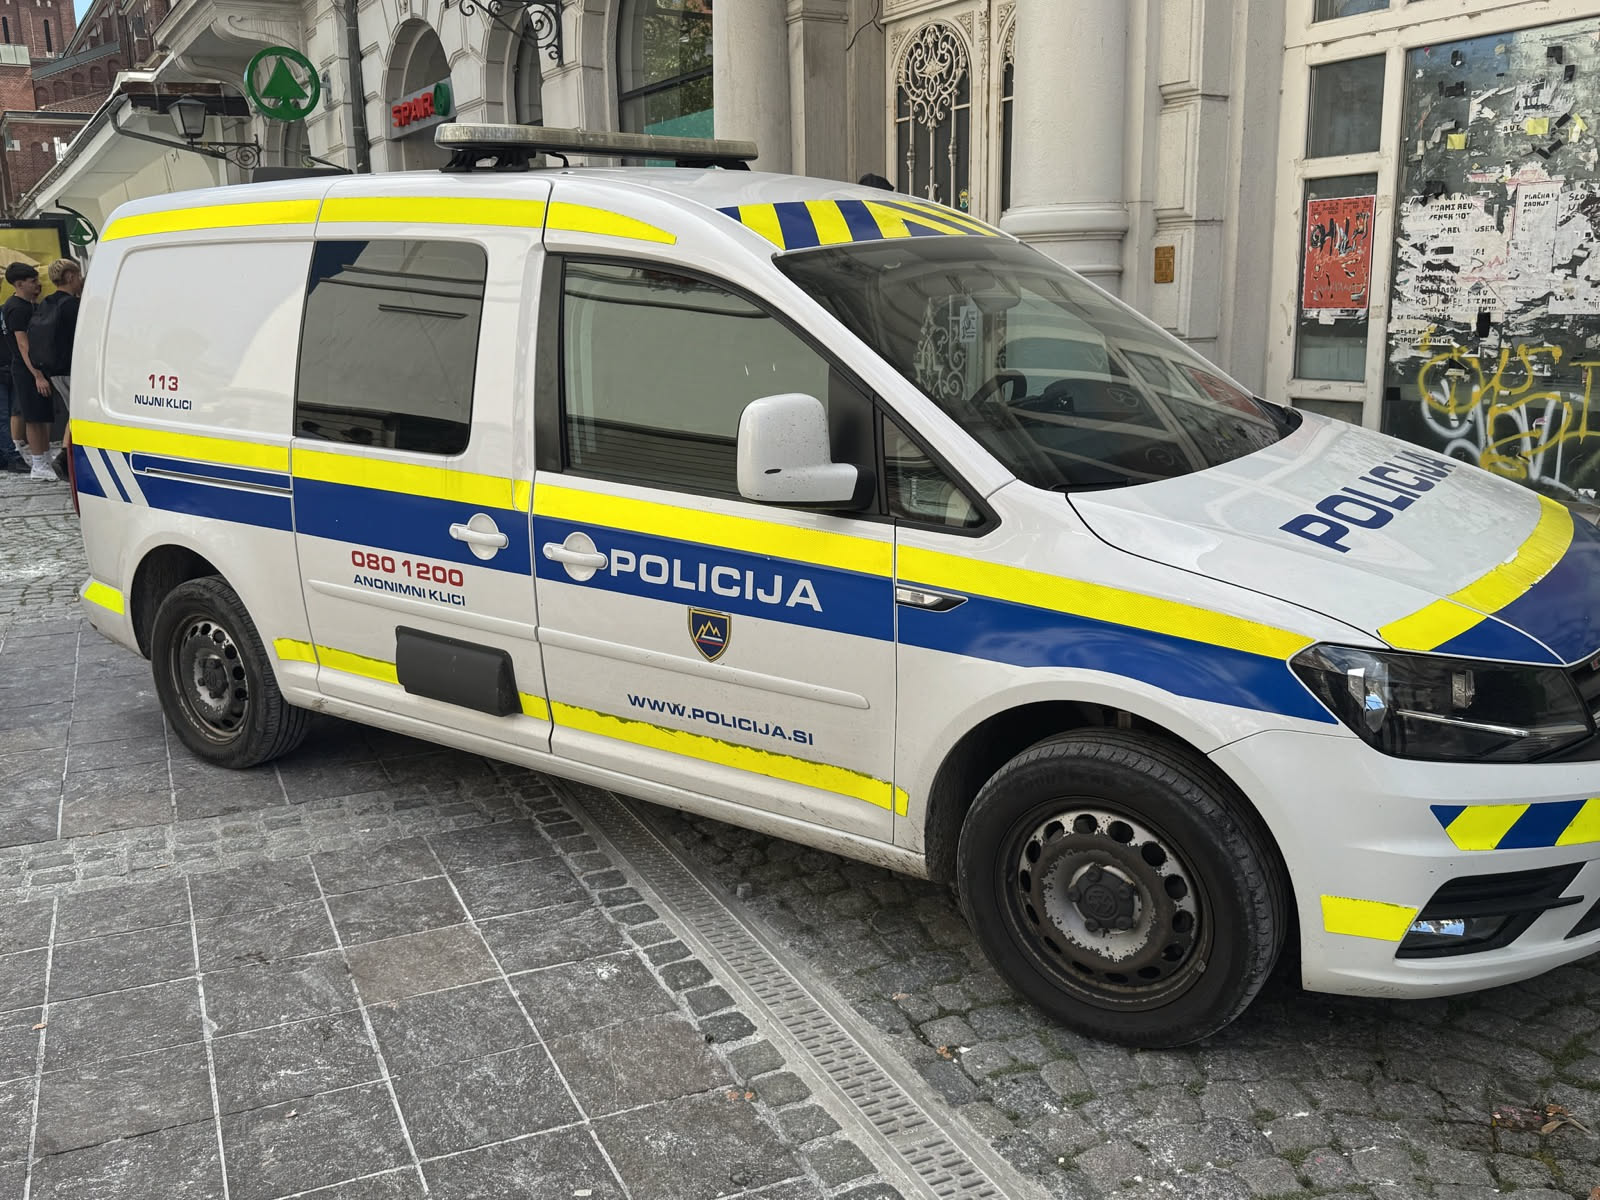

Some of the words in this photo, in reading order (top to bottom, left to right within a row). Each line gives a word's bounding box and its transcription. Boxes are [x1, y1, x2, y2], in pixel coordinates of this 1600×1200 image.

[391, 92, 435, 128] SPAR
[148, 374, 179, 391] 113
[134, 394, 164, 407] NUJNI
[166, 398, 192, 410] KLICI
[1278, 450, 1457, 553] POLICIJA
[351, 550, 396, 574] 080
[401, 560, 464, 587] 1200
[610, 548, 823, 613] POLICIJA
[353, 574, 426, 599] ANONIMNI
[428, 589, 466, 606] KLICI
[627, 693, 815, 746] WWW.POLICIJA.SI
